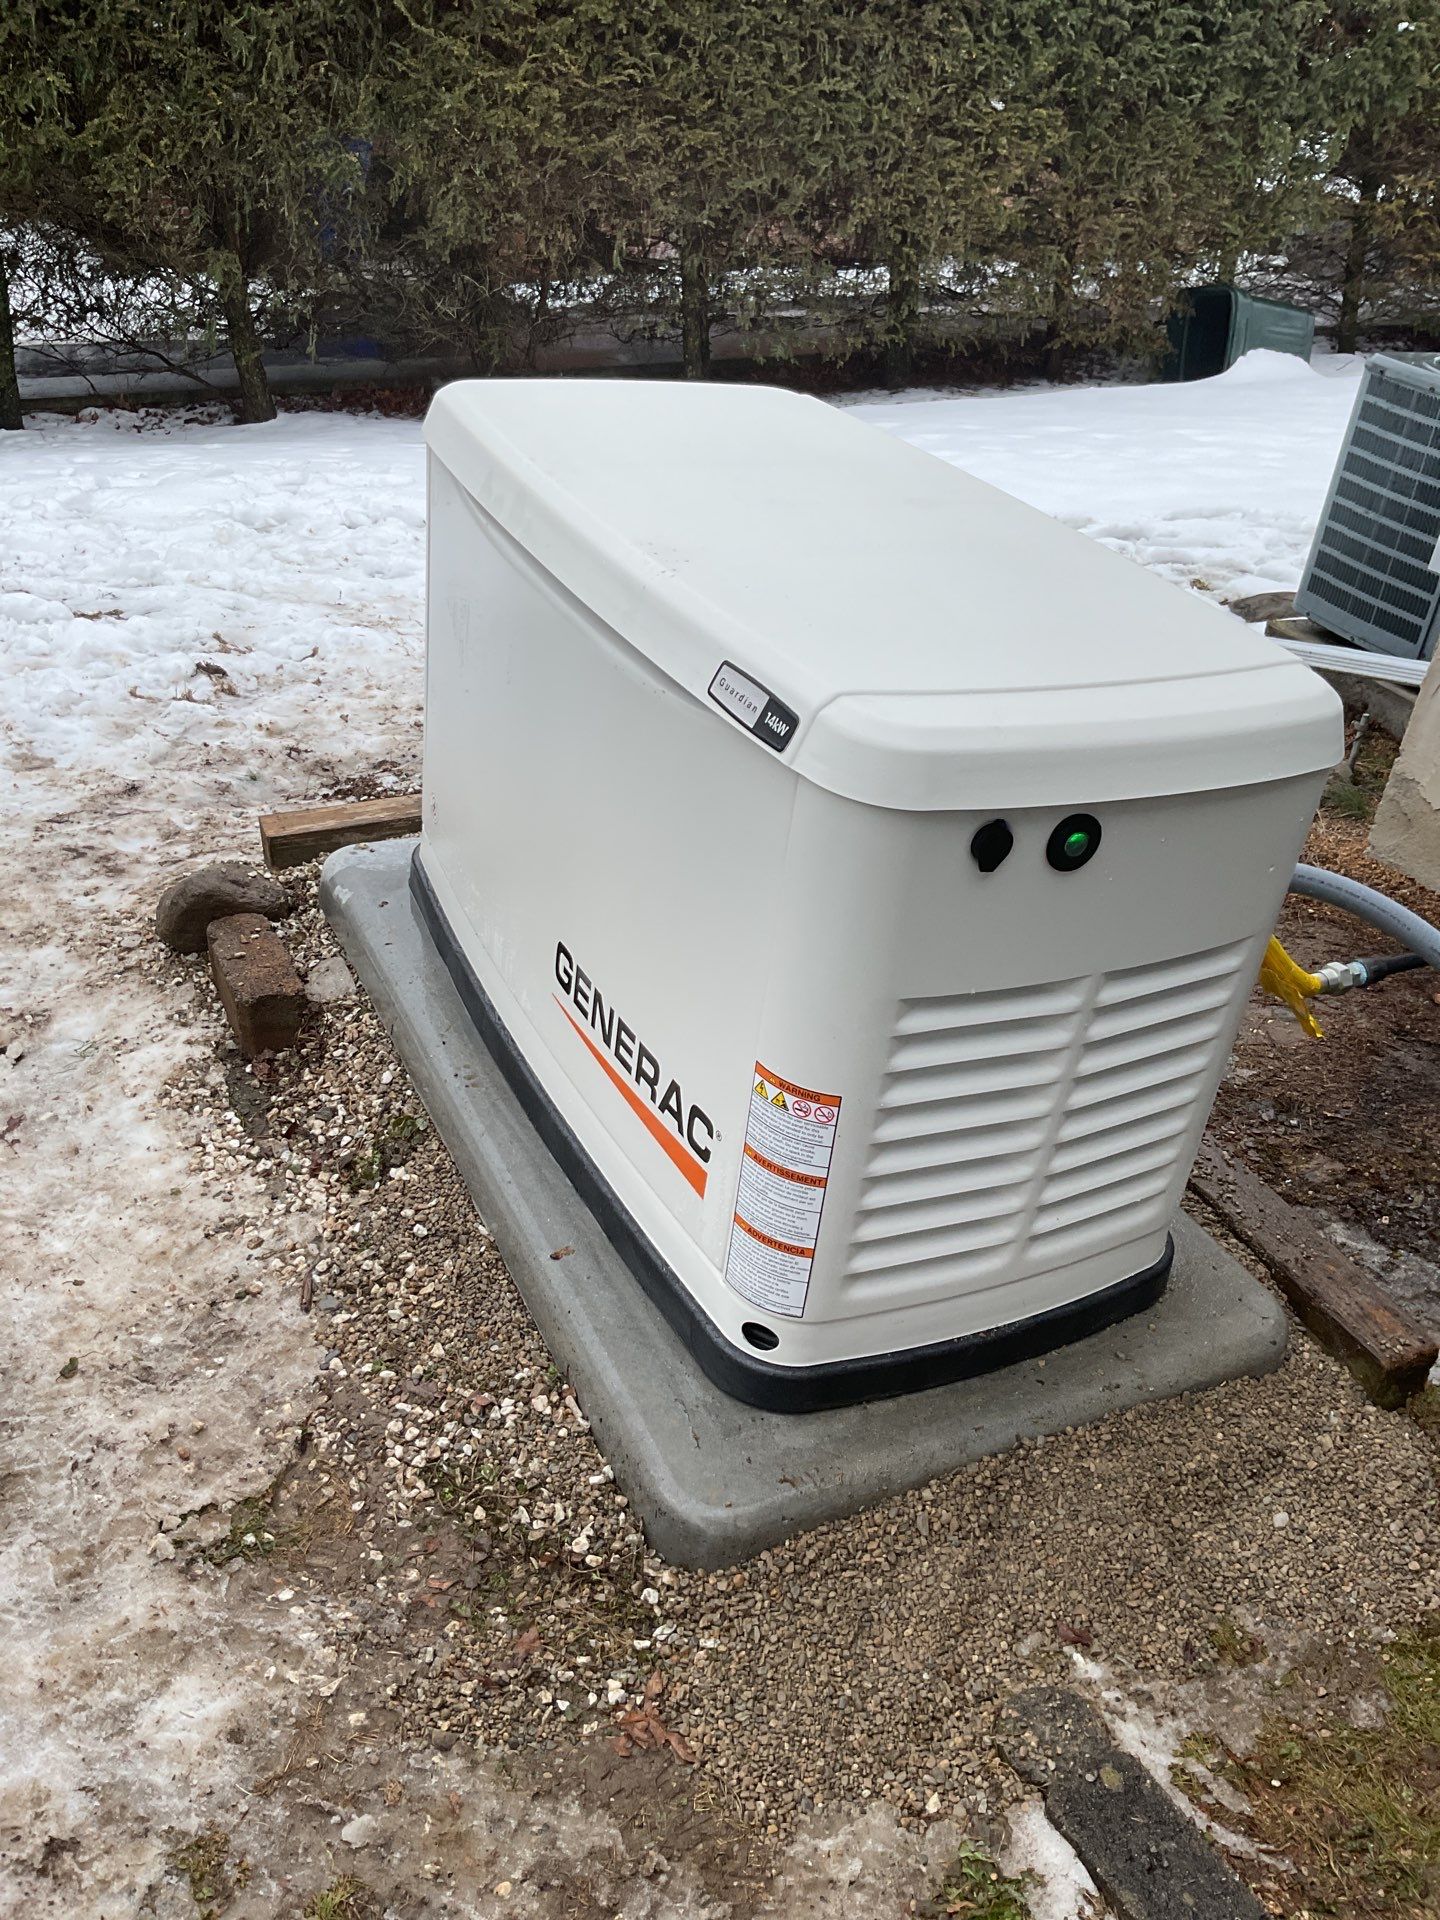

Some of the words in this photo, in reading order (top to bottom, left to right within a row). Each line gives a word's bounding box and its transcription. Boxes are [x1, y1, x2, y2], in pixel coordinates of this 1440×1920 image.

[719, 677, 758, 714] Guardian
[764, 711, 790, 737] 14kW
[555, 940, 714, 1163] GENERAC
[778, 1081, 821, 1102] WARNING
[753, 1154, 823, 1186] AVERTISSEMENT
[746, 1227, 806, 1256] ADVERTENCIA
